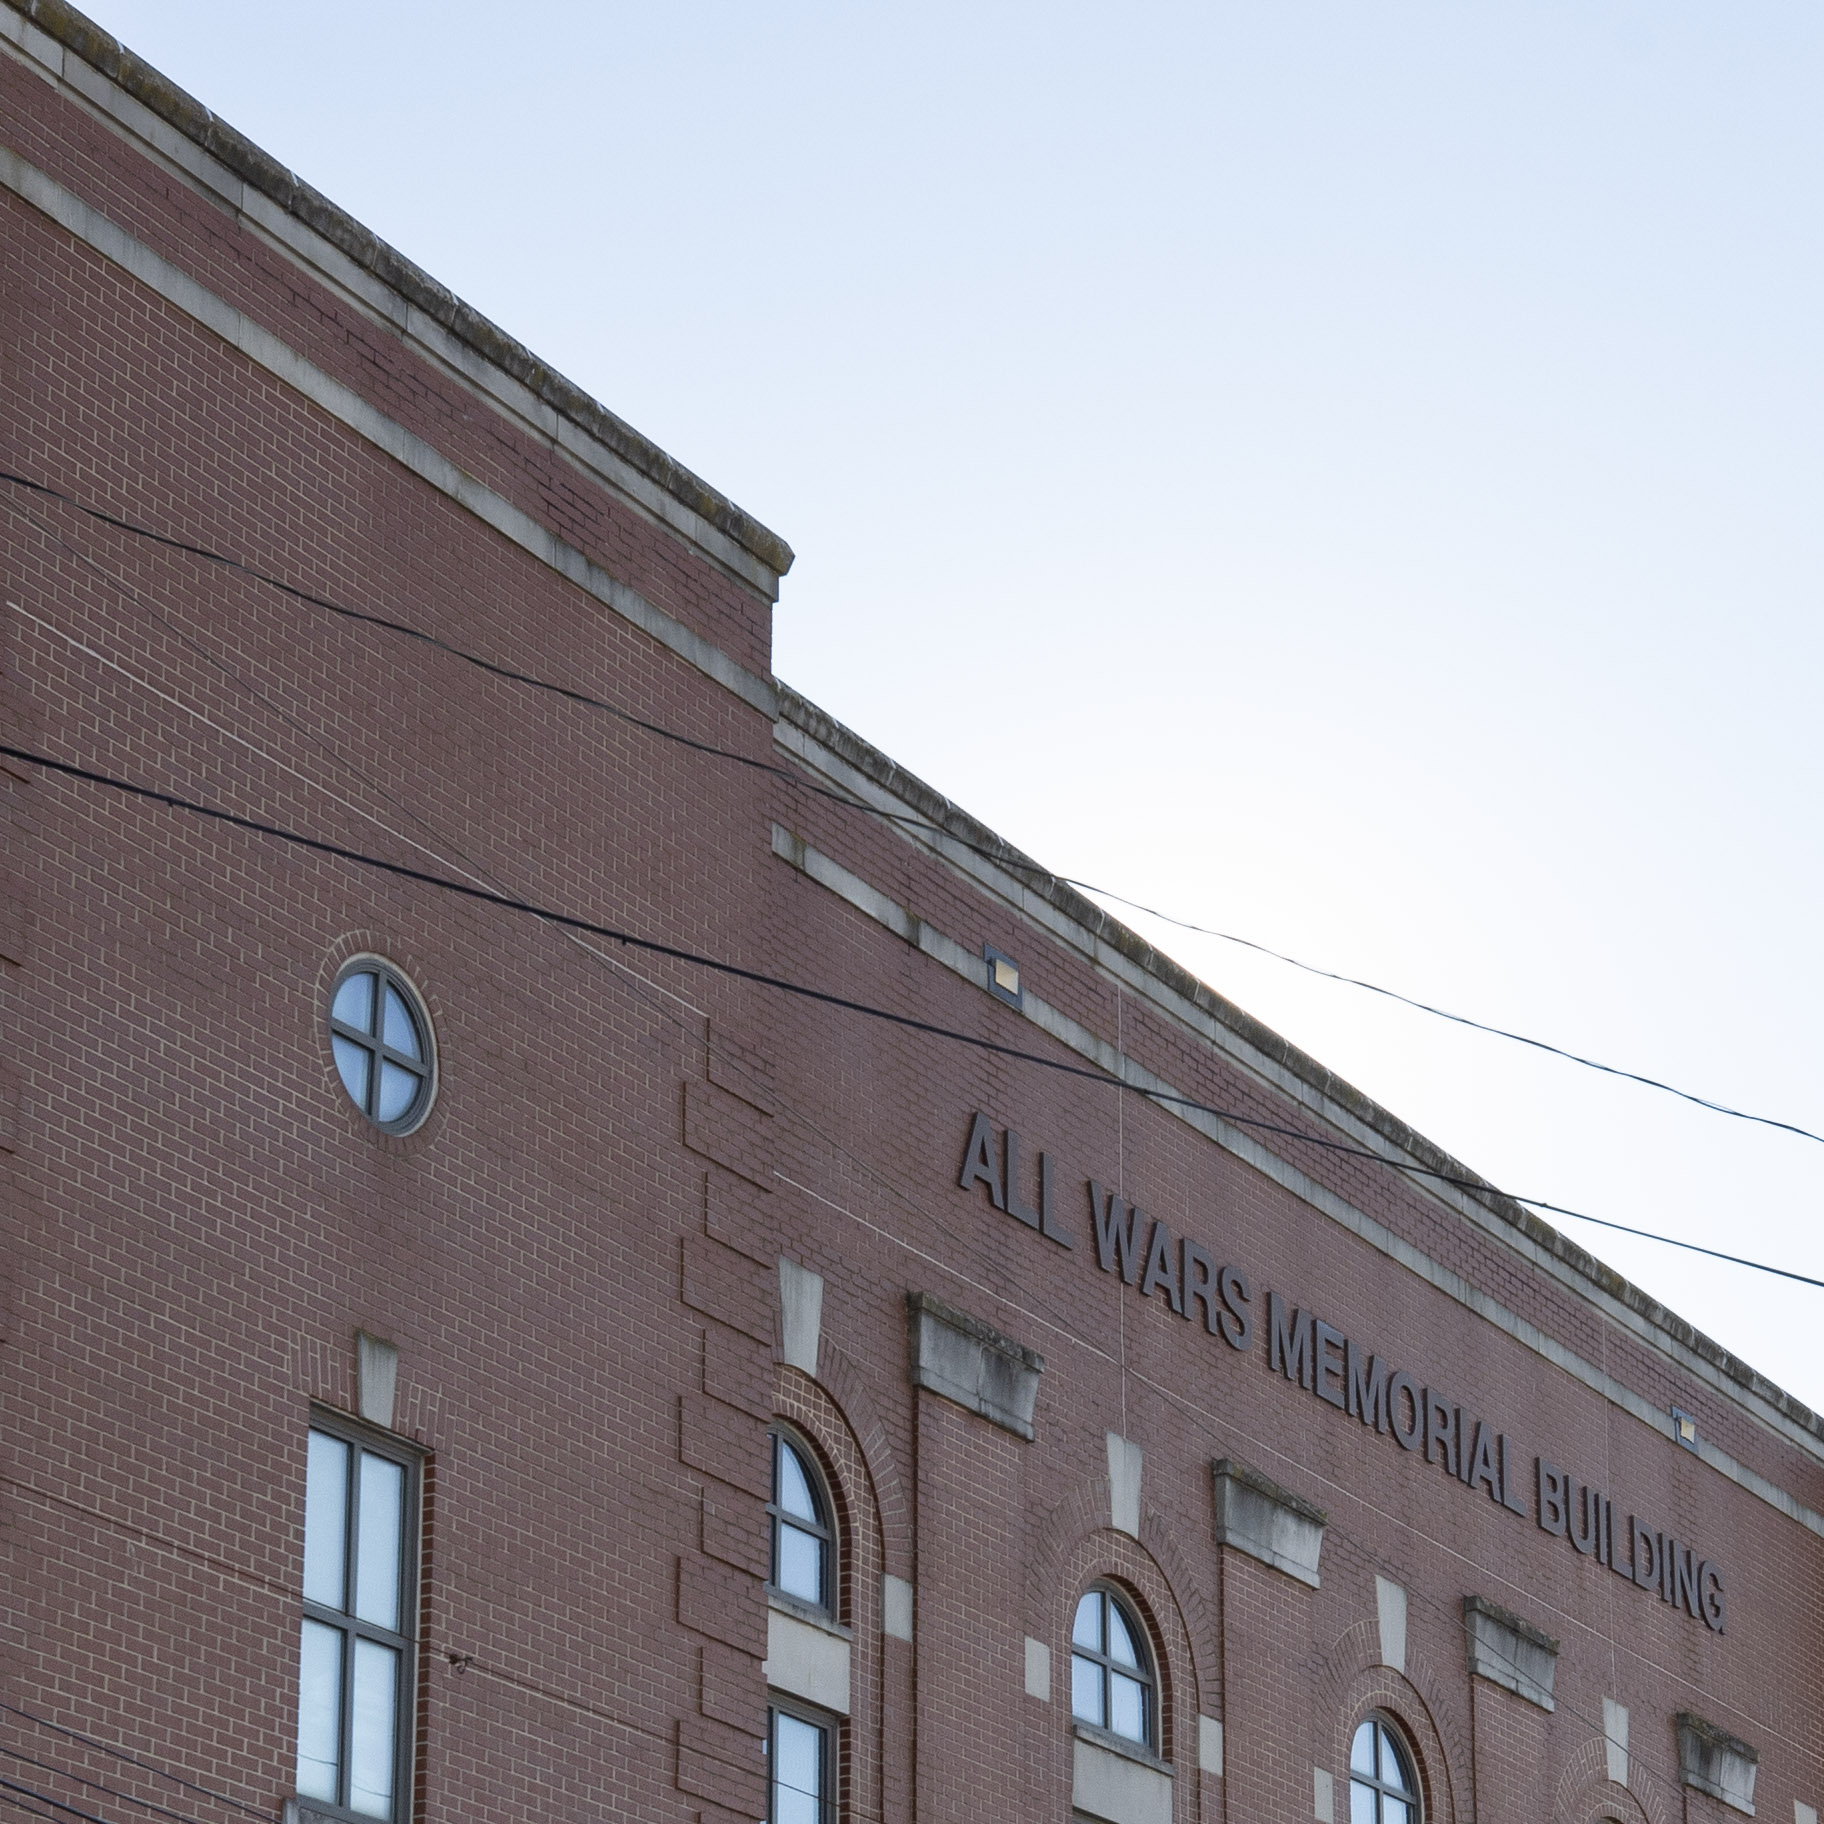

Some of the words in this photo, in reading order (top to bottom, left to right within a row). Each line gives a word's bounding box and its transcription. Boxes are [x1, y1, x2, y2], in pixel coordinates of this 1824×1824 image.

[959, 1111, 1073, 1251] ALL
[1088, 1179, 1252, 1351] WARS
[1267, 1291, 1526, 1518] MEMORIAL
[1534, 1456, 1725, 1635] BUILDING
